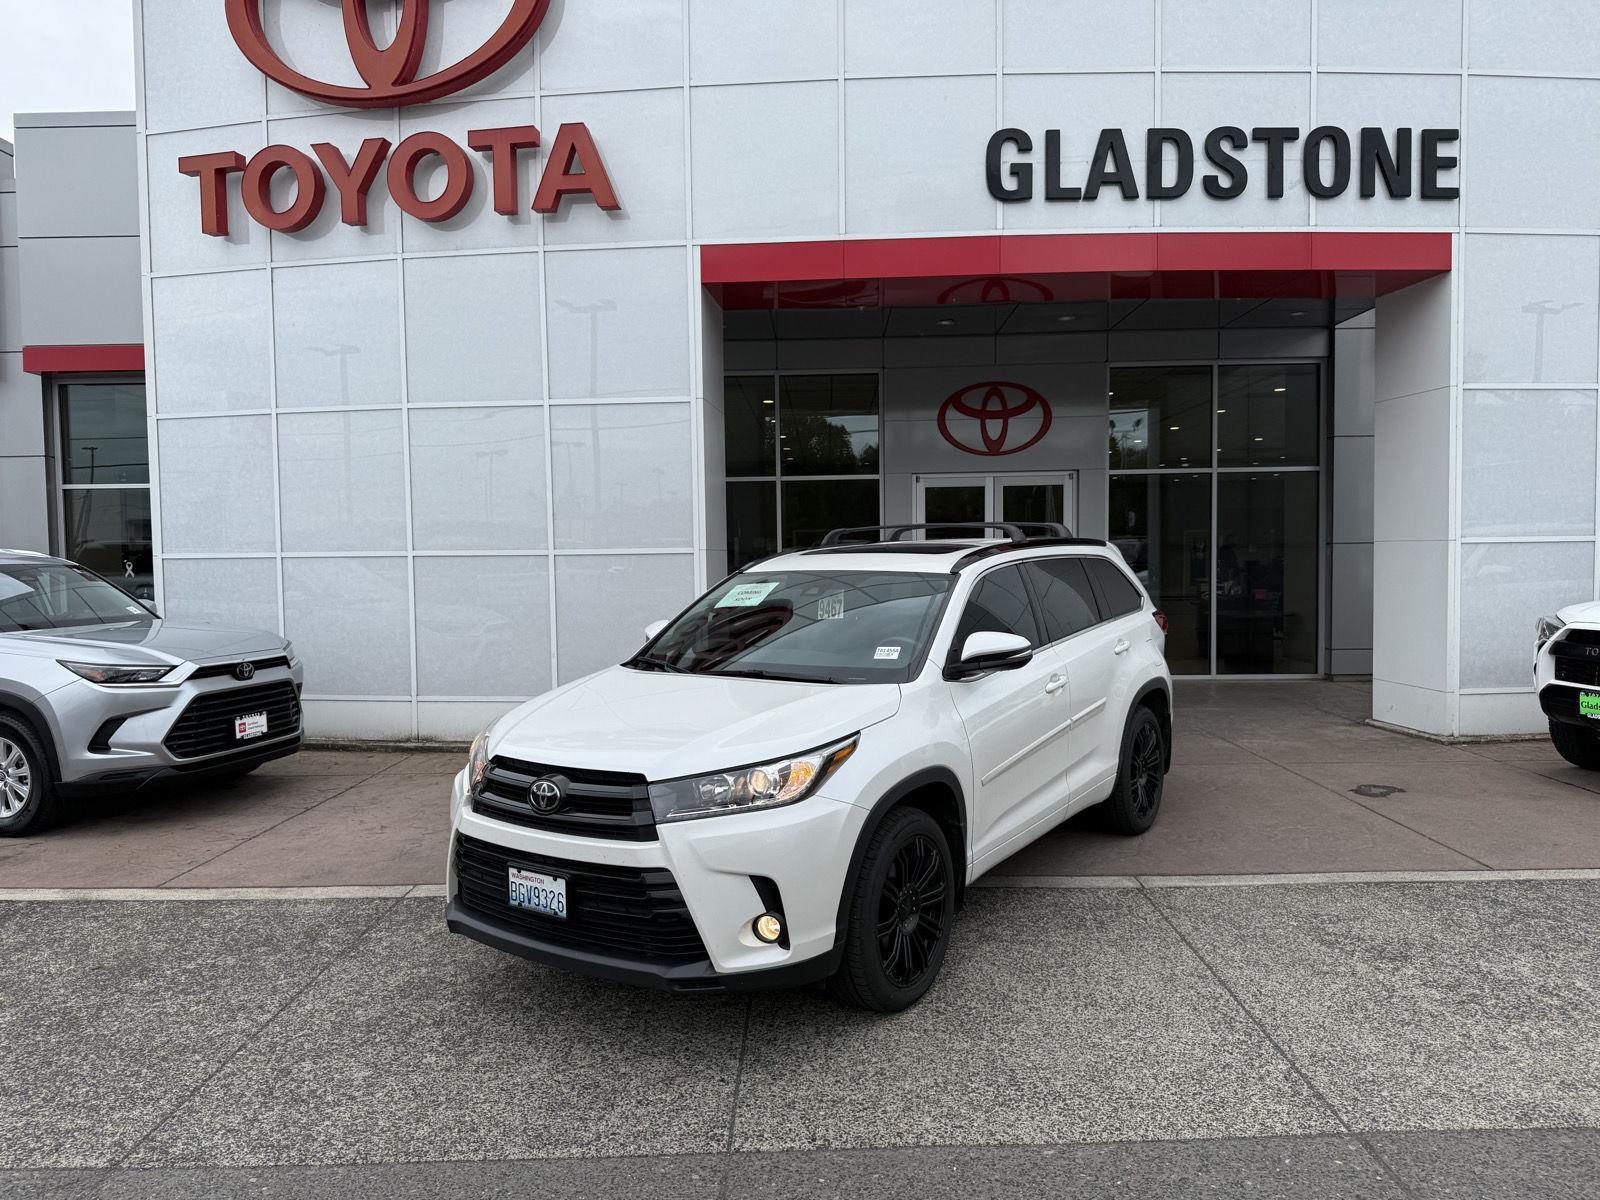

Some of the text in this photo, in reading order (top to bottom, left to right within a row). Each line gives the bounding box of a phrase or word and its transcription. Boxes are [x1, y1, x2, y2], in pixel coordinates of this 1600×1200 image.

[178, 122, 622, 237] TOYOTA
[985, 125, 1460, 202] GLADSTONE
[818, 598, 843, 619] 9467
[511, 872, 545, 885] WASHINGTON
[510, 880, 565, 913] BGV9326
